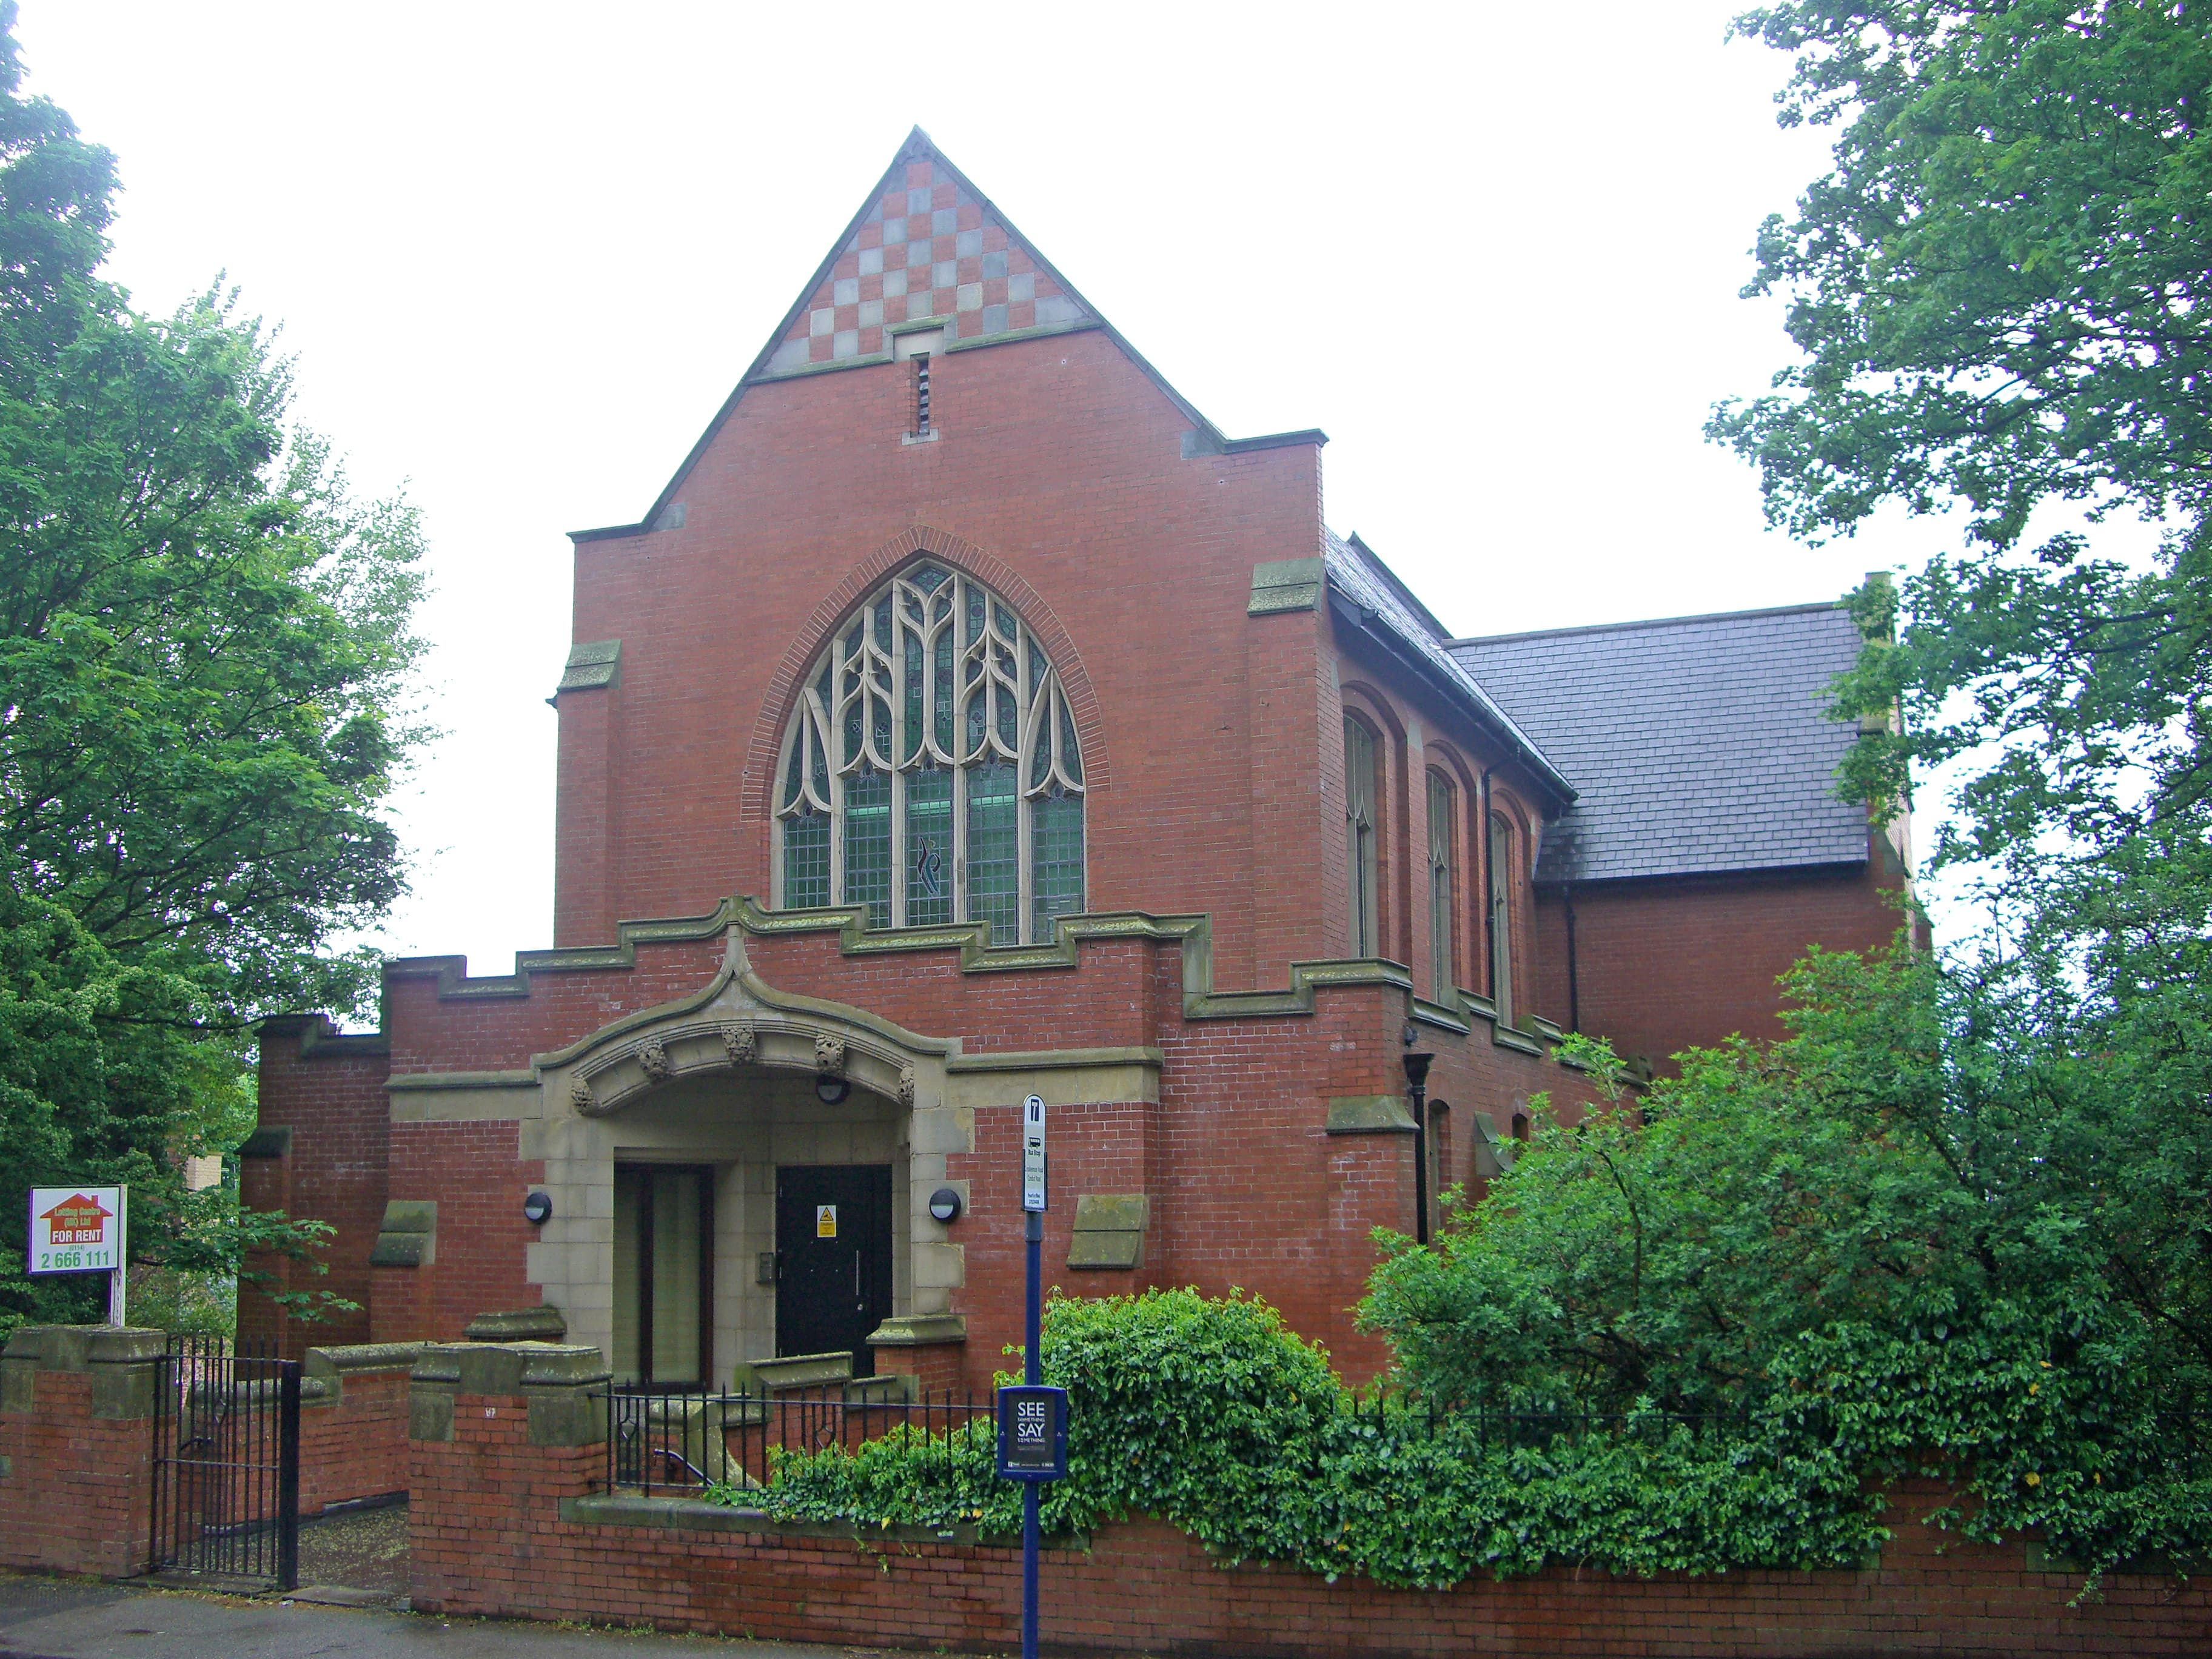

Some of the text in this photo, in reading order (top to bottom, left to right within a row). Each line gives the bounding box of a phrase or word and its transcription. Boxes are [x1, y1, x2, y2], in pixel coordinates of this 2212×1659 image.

[54, 1207, 78, 1217] Letting
[79, 1217, 91, 1225] Ltd
[52, 1228, 102, 1242] FOR RENT
[41, 1250, 109, 1269] 2 666 111
[1017, 1402, 1045, 1416] SEE
[1017, 1423, 1045, 1437] SAY
